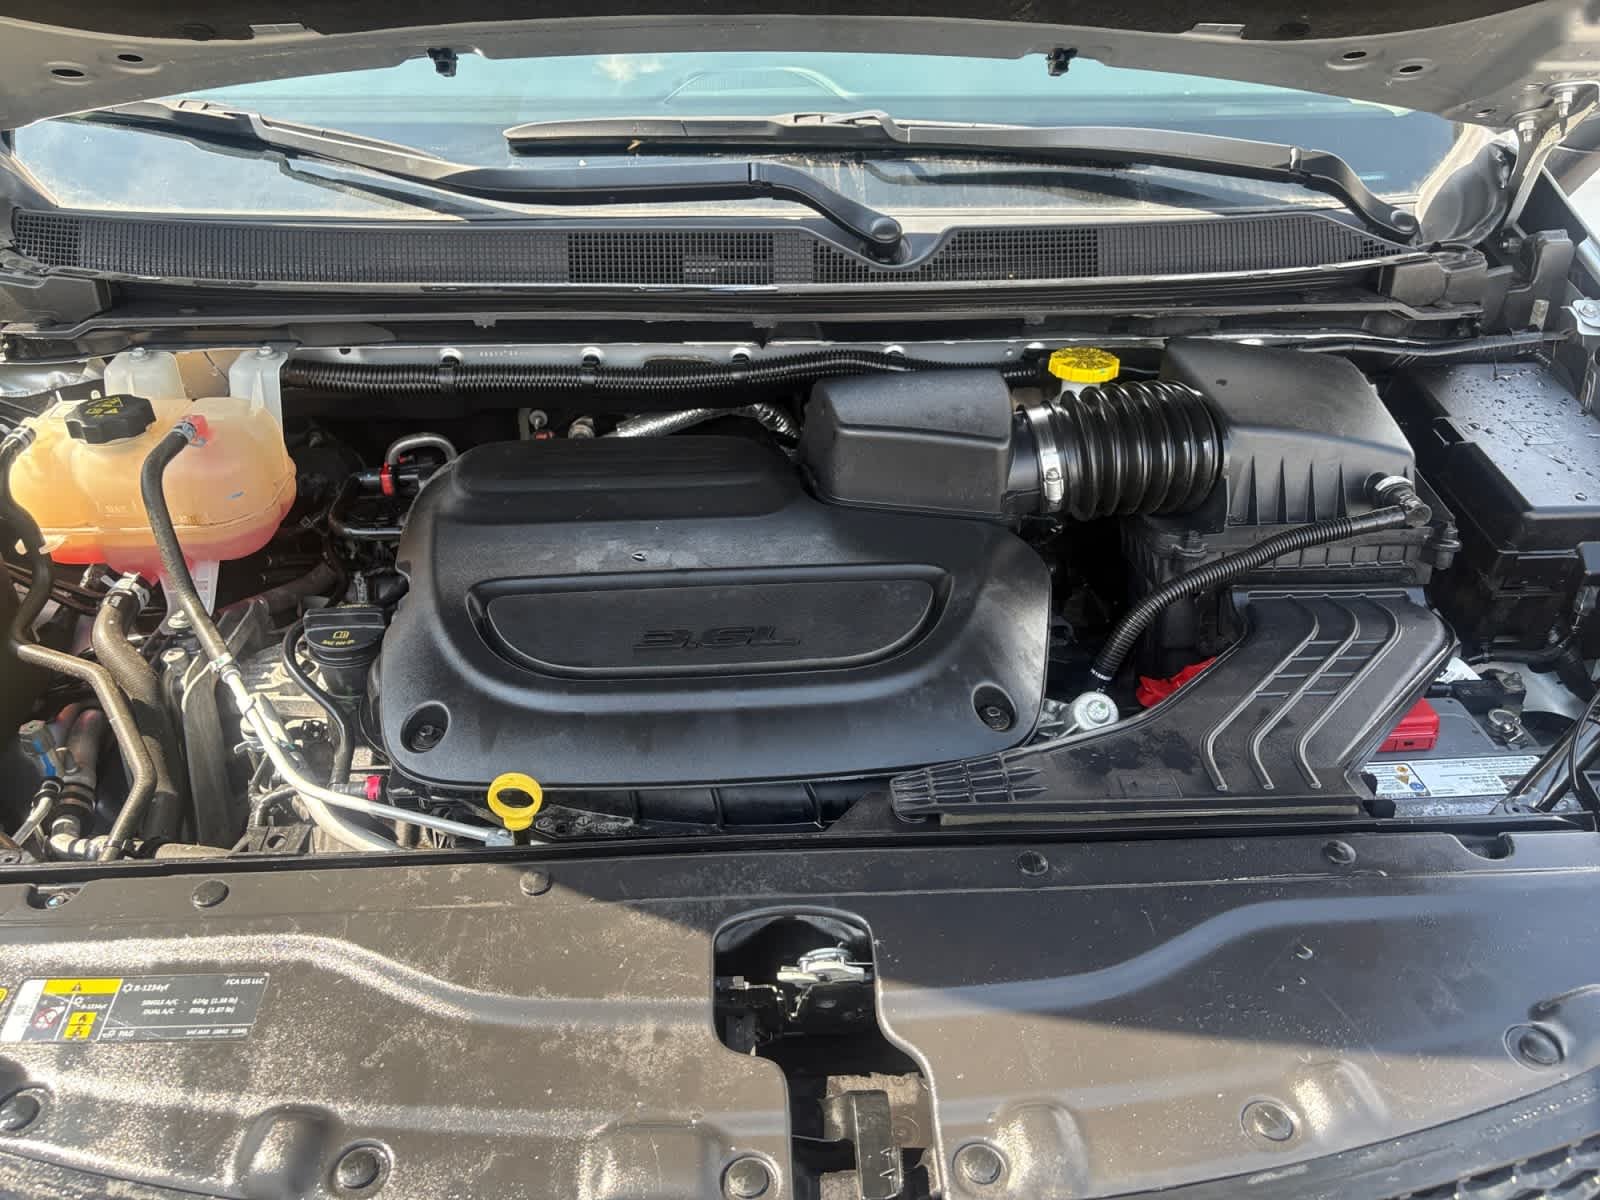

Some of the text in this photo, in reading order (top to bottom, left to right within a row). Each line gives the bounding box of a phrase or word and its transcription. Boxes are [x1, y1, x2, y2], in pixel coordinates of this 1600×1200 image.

[633, 625, 802, 649] 3.6L
[225, 978, 240, 986] FCA
[250, 977, 265, 985] LLC
